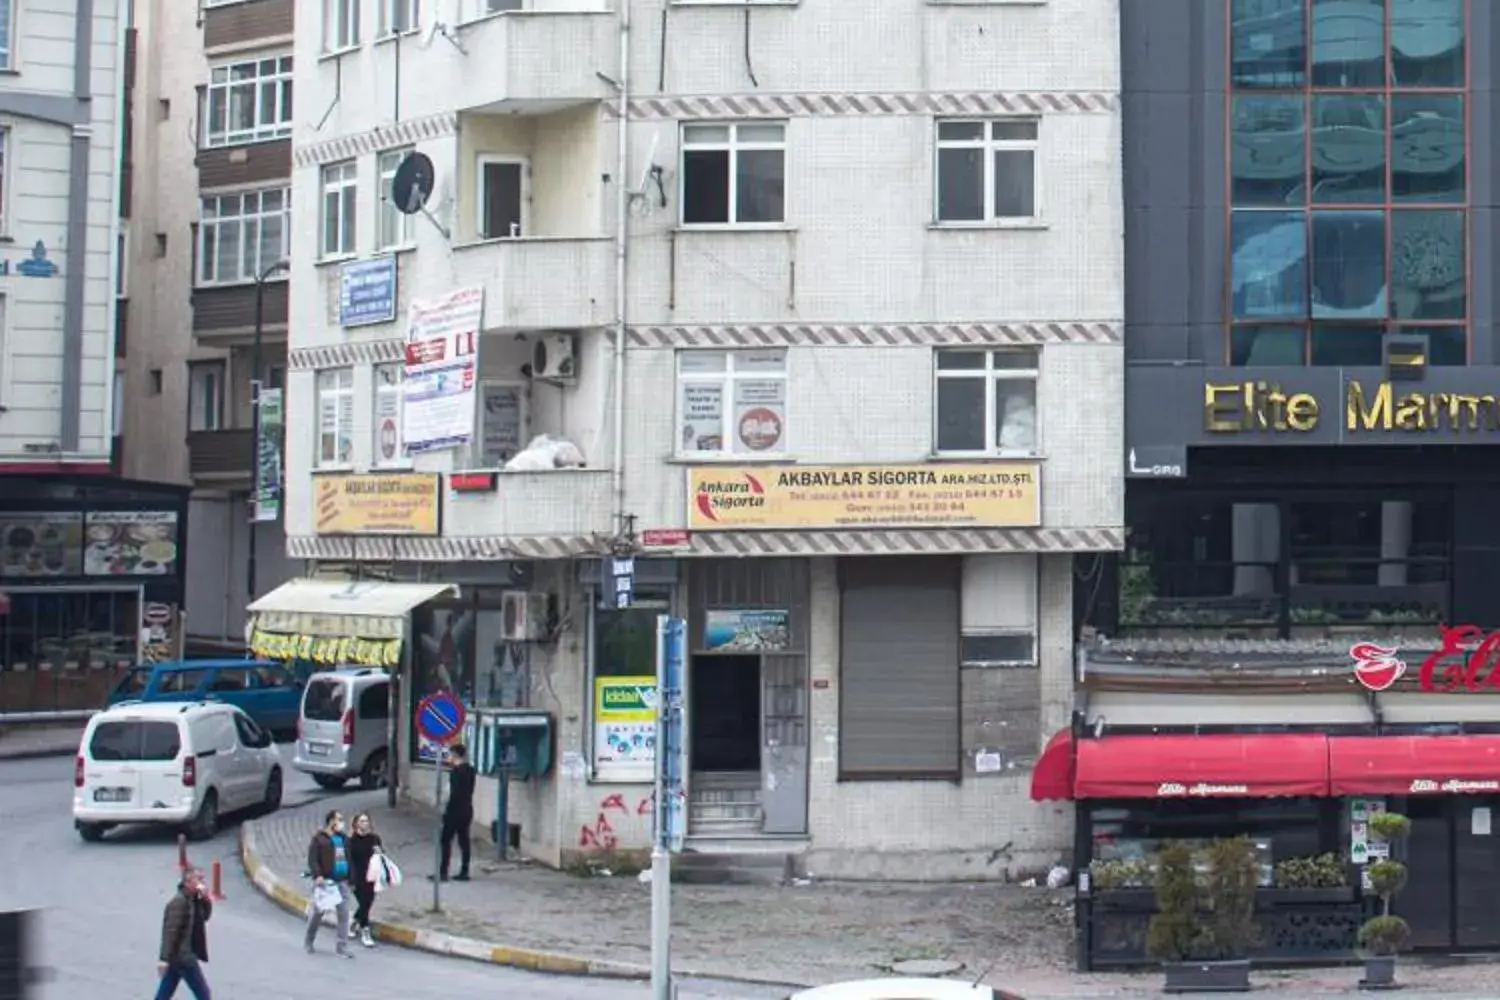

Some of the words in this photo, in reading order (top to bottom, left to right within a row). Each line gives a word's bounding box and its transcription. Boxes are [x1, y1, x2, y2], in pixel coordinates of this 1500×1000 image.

[1205, 382, 1318, 432] Elite
[778, 471, 863, 486] AKBAYLAR
[867, 470, 937, 485] SİGORTA
[698, 480, 750, 494] Ankara
[712, 494, 765, 509] Sigorta
